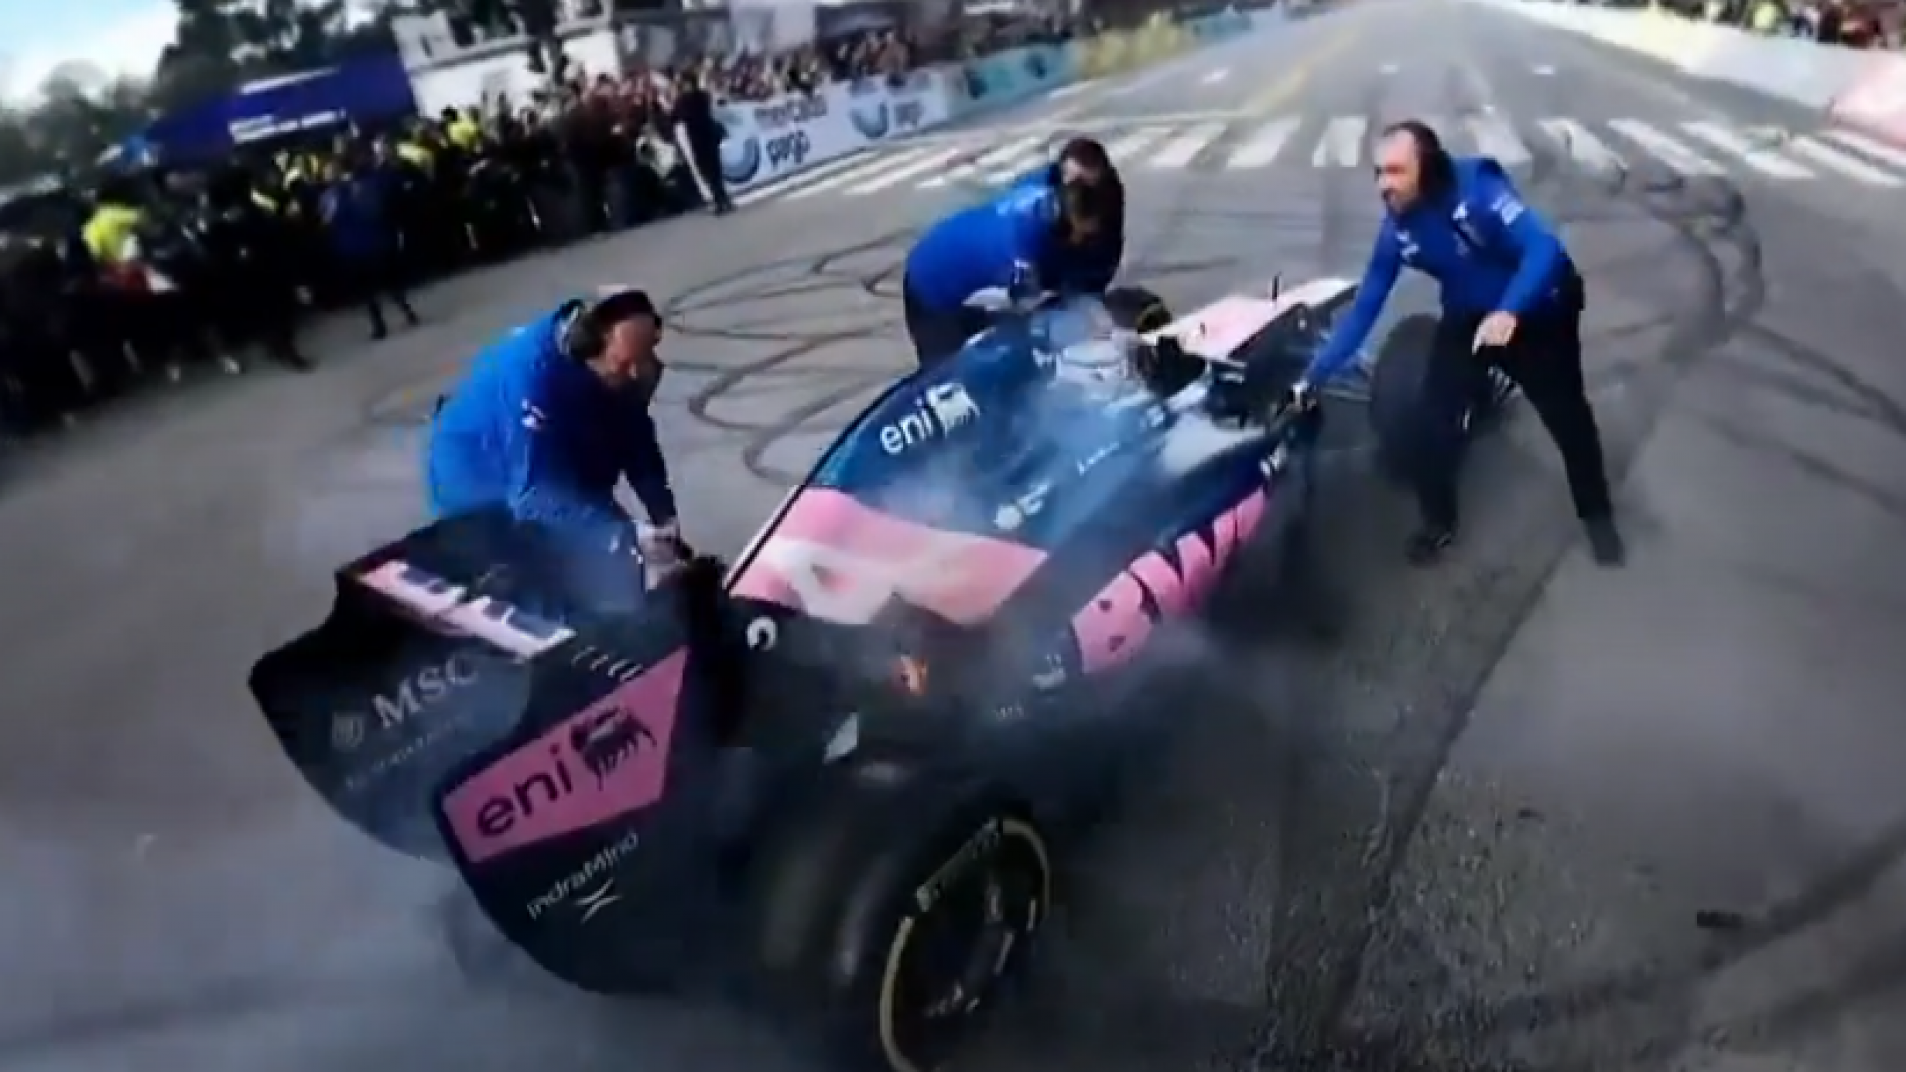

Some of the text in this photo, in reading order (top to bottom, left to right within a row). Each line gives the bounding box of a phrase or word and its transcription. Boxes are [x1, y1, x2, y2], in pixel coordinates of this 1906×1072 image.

[881, 397, 934, 455] eni
[371, 652, 479, 729] MSC
[477, 743, 573, 837] eni
